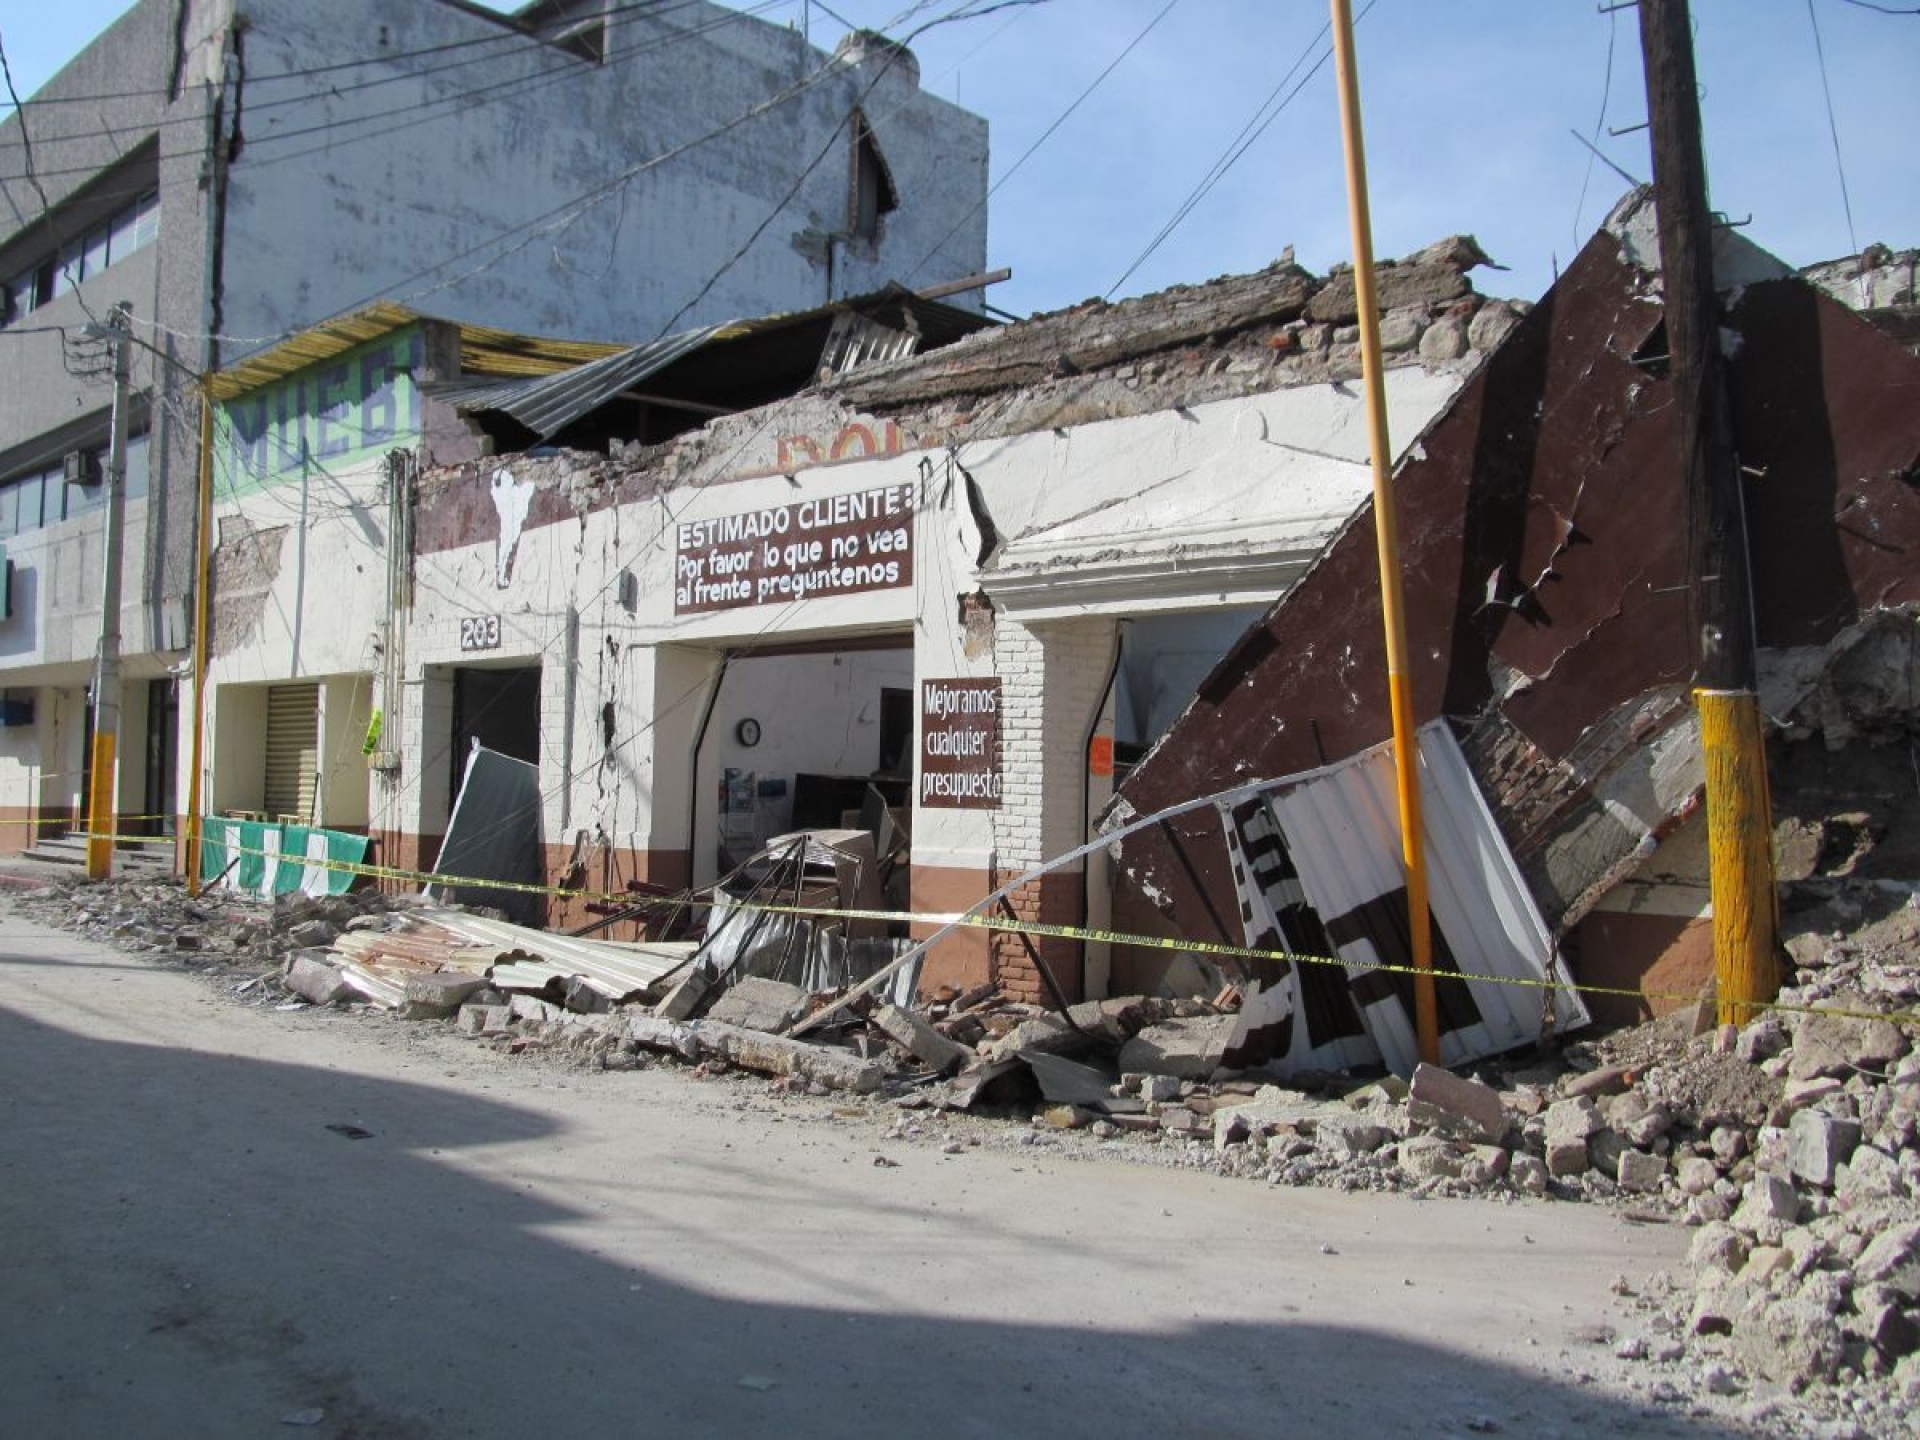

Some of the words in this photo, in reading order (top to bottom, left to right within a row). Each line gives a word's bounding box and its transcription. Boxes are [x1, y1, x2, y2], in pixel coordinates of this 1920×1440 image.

[679, 506, 789, 550] ESTIMADO
[798, 486, 914, 530] CLIENTE:
[677, 554, 705, 580] Por
[709, 548, 754, 574] favor
[764, 540, 780, 569] lo
[783, 540, 823, 570] que
[831, 534, 859, 559] no
[867, 527, 908, 555] vea
[676, 580, 692, 606] al
[694, 577, 751, 604] frente
[924, 684, 996, 720] Mejoramos
[927, 724, 988, 761] cualquier
[922, 767, 1001, 804] presupuesto
